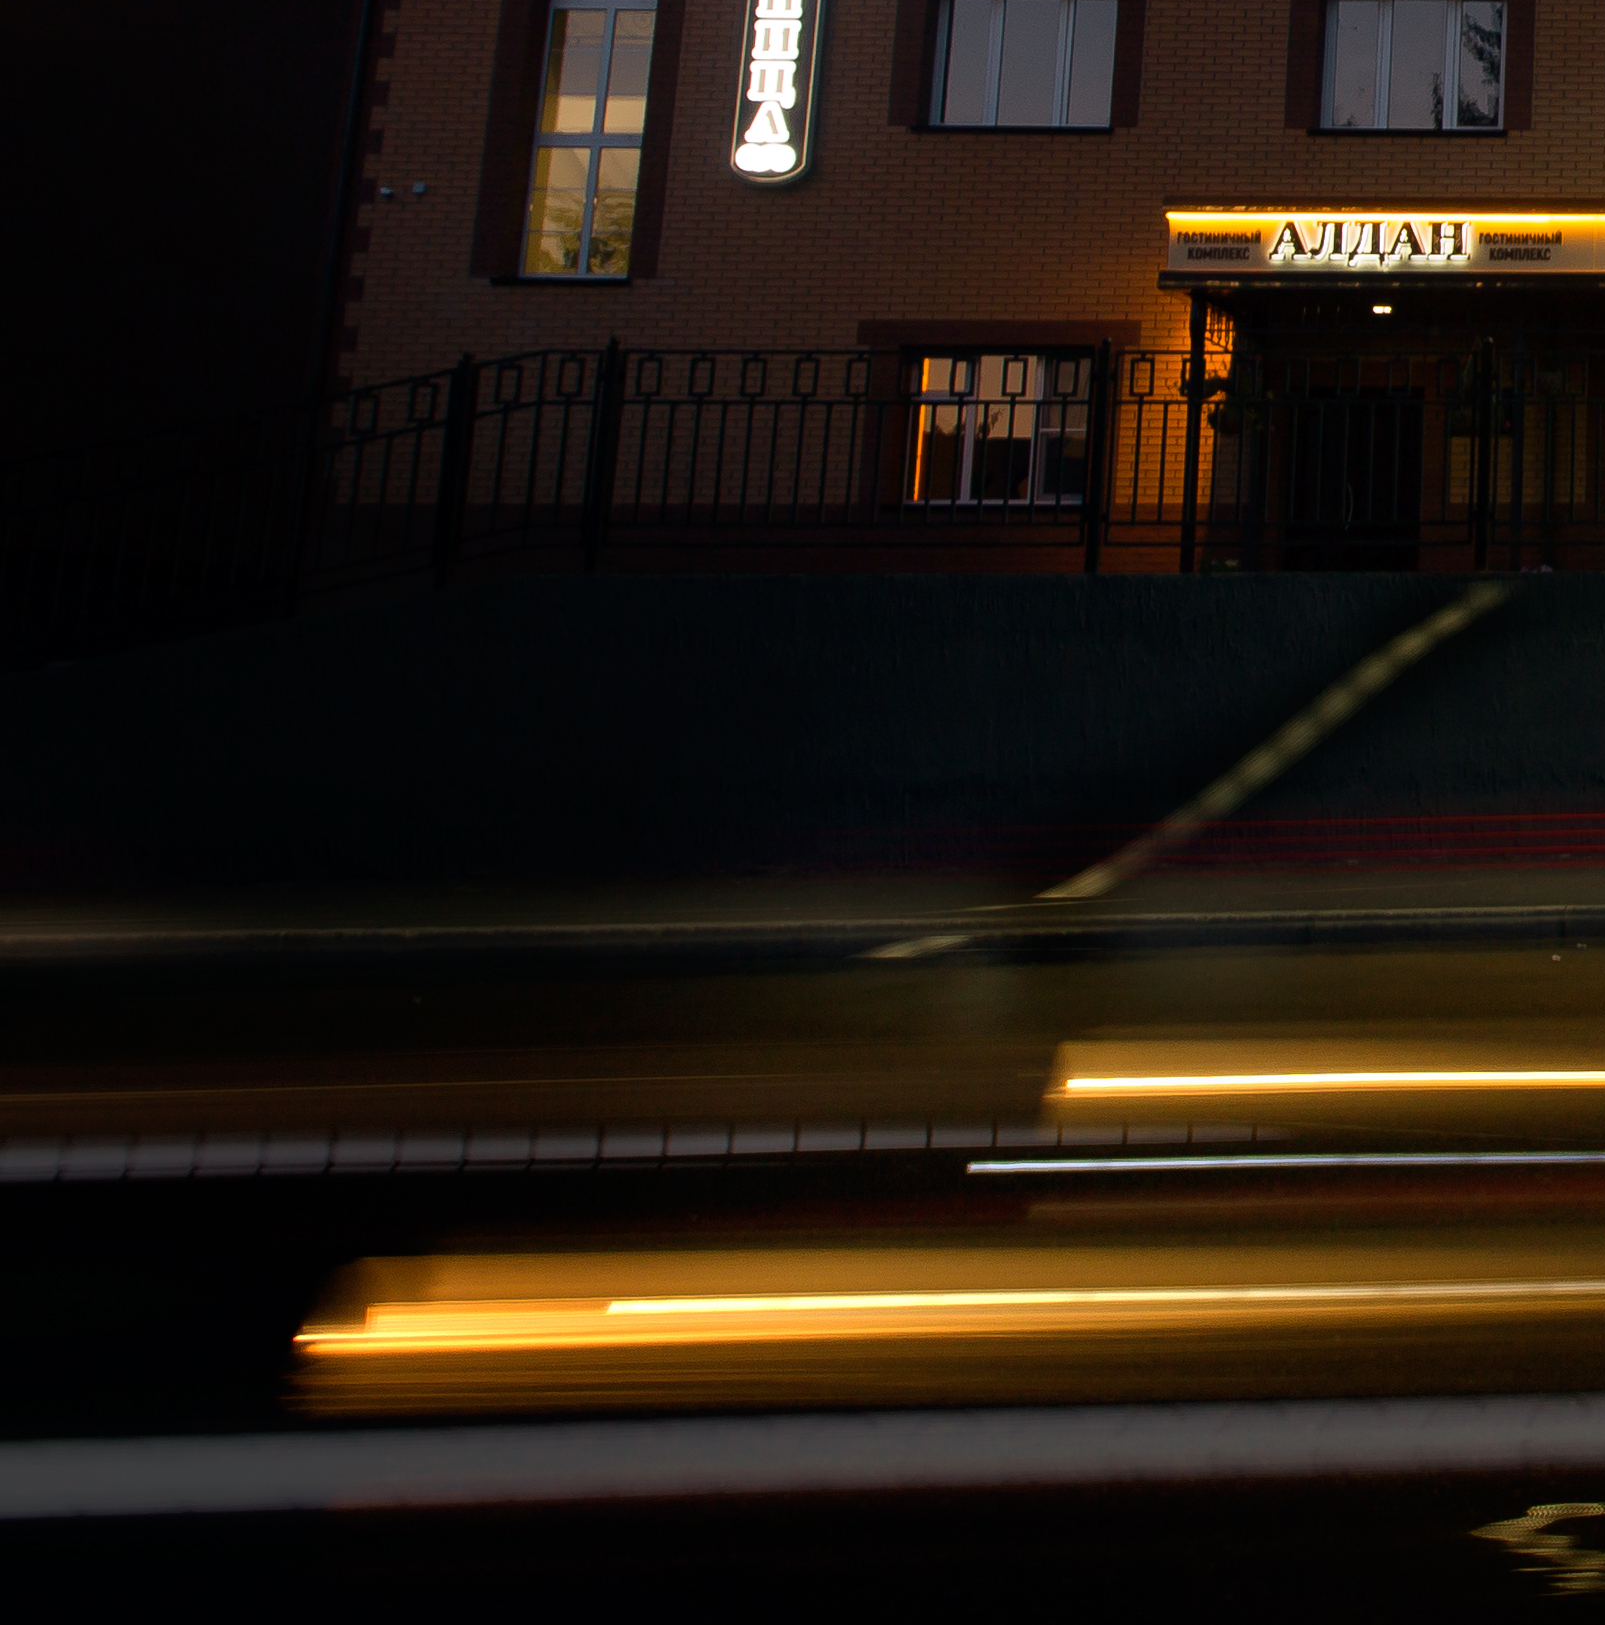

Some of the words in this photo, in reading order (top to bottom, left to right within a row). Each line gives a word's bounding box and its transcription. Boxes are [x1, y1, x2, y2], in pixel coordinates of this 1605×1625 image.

[1176, 228, 1262, 245] ГОСТИНИЧНЫЙ
[1268, 220, 1472, 268] АЛДАН
[1478, 229, 1563, 245] ГОСТИНИЧНЫЙ
[1187, 246, 1251, 261] КОМПЛЕКС
[1488, 247, 1552, 262] КОМПЛЕКС
